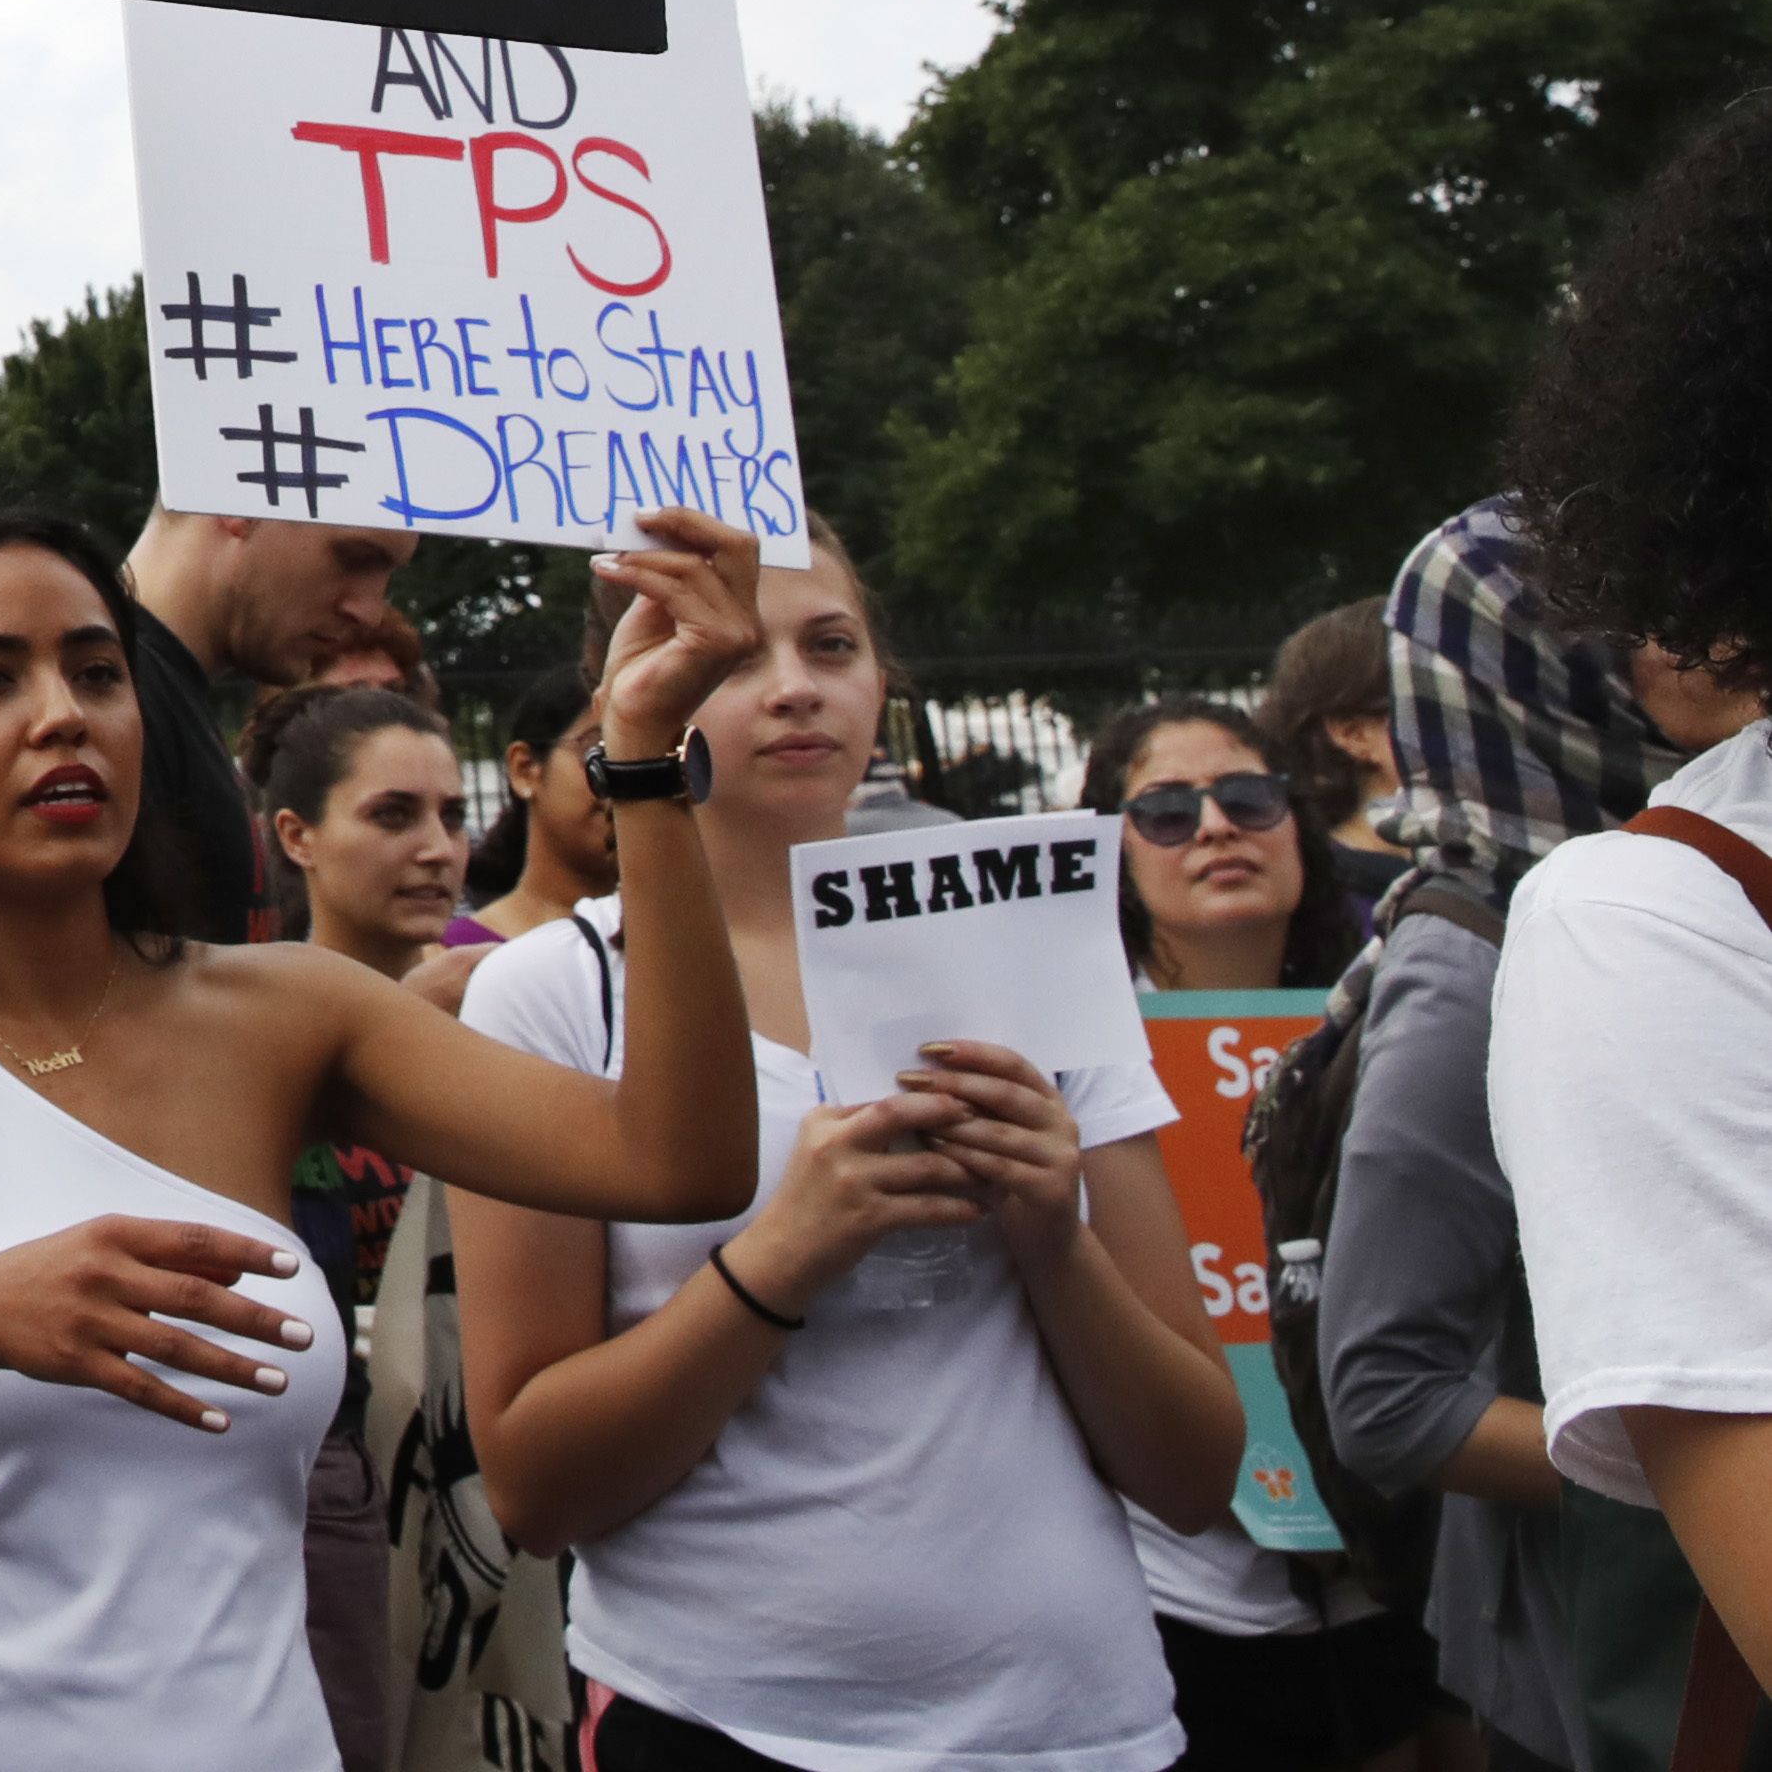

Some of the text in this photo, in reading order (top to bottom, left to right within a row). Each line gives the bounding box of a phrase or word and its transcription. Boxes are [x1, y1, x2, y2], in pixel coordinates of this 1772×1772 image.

[370, 27, 577, 129] AND
[290, 121, 672, 297] TPS
[812, 839, 1097, 929] SHAME
